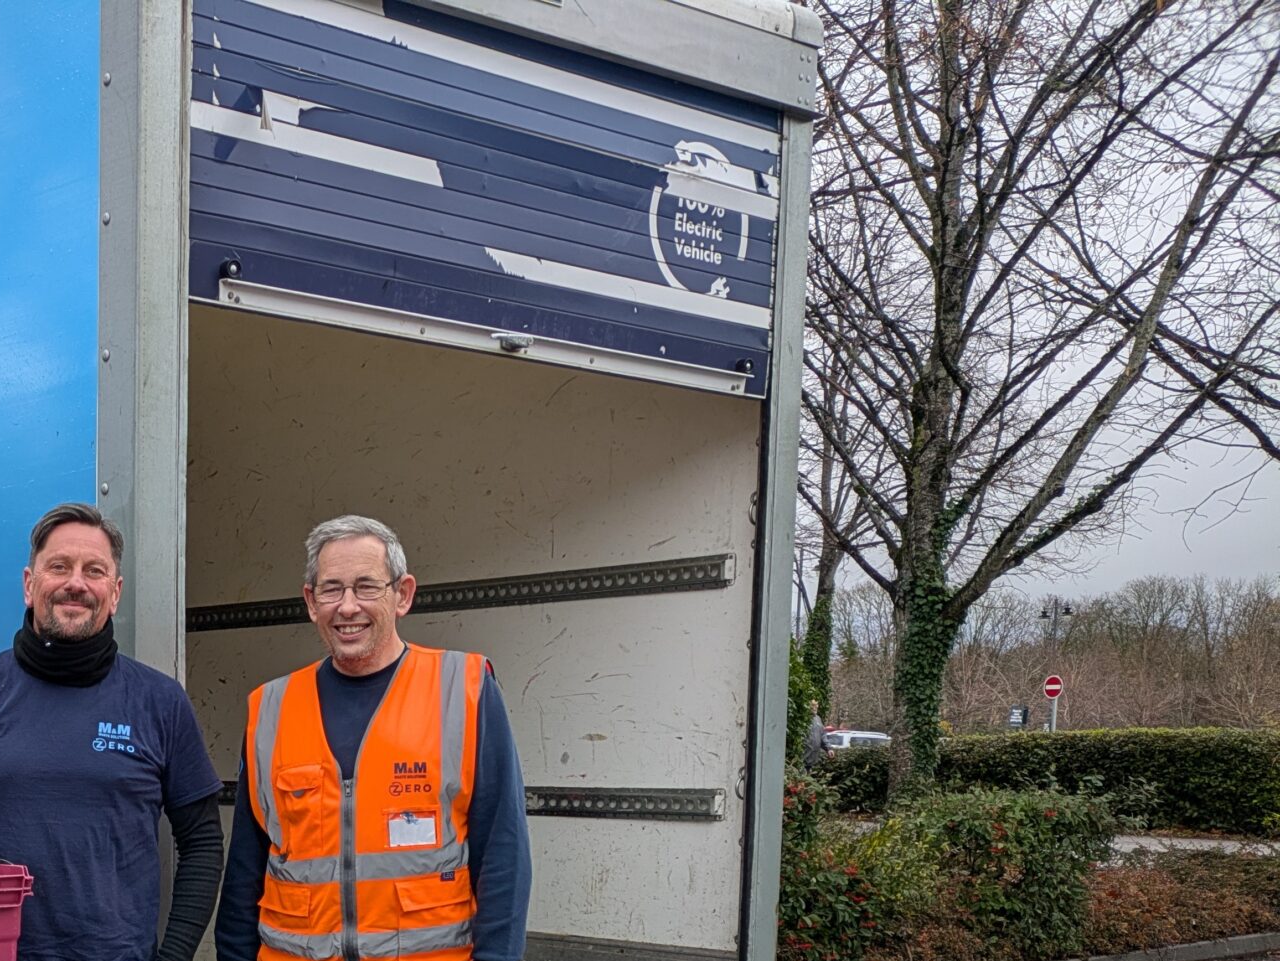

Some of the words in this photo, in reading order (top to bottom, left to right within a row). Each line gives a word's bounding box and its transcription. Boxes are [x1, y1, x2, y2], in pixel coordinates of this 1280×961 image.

[674, 212, 723, 241] Electric
[674, 236, 723, 265] Vehicle
[92, 737, 135, 753] ZERO
[388, 781, 432, 796] ZERO
